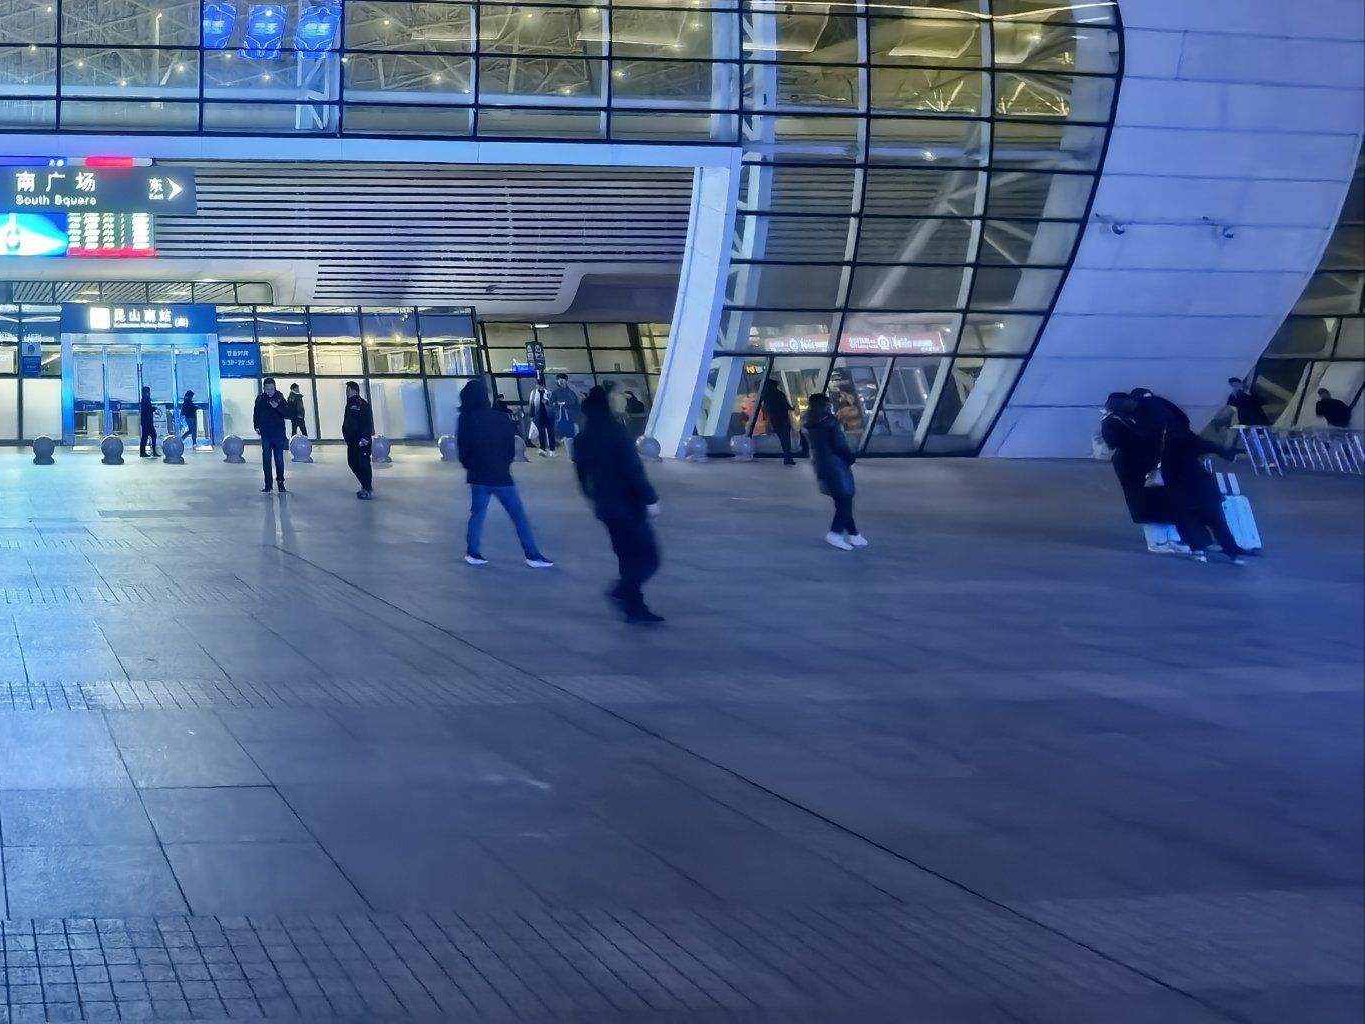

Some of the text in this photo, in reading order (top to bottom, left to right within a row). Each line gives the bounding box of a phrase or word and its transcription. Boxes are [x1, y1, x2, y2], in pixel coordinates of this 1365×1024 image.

[15, 171, 96, 192] 南广场
[148, 177, 163, 193] 东
[15, 195, 96, 207] South Square
[114, 308, 172, 323] 昆山南站
